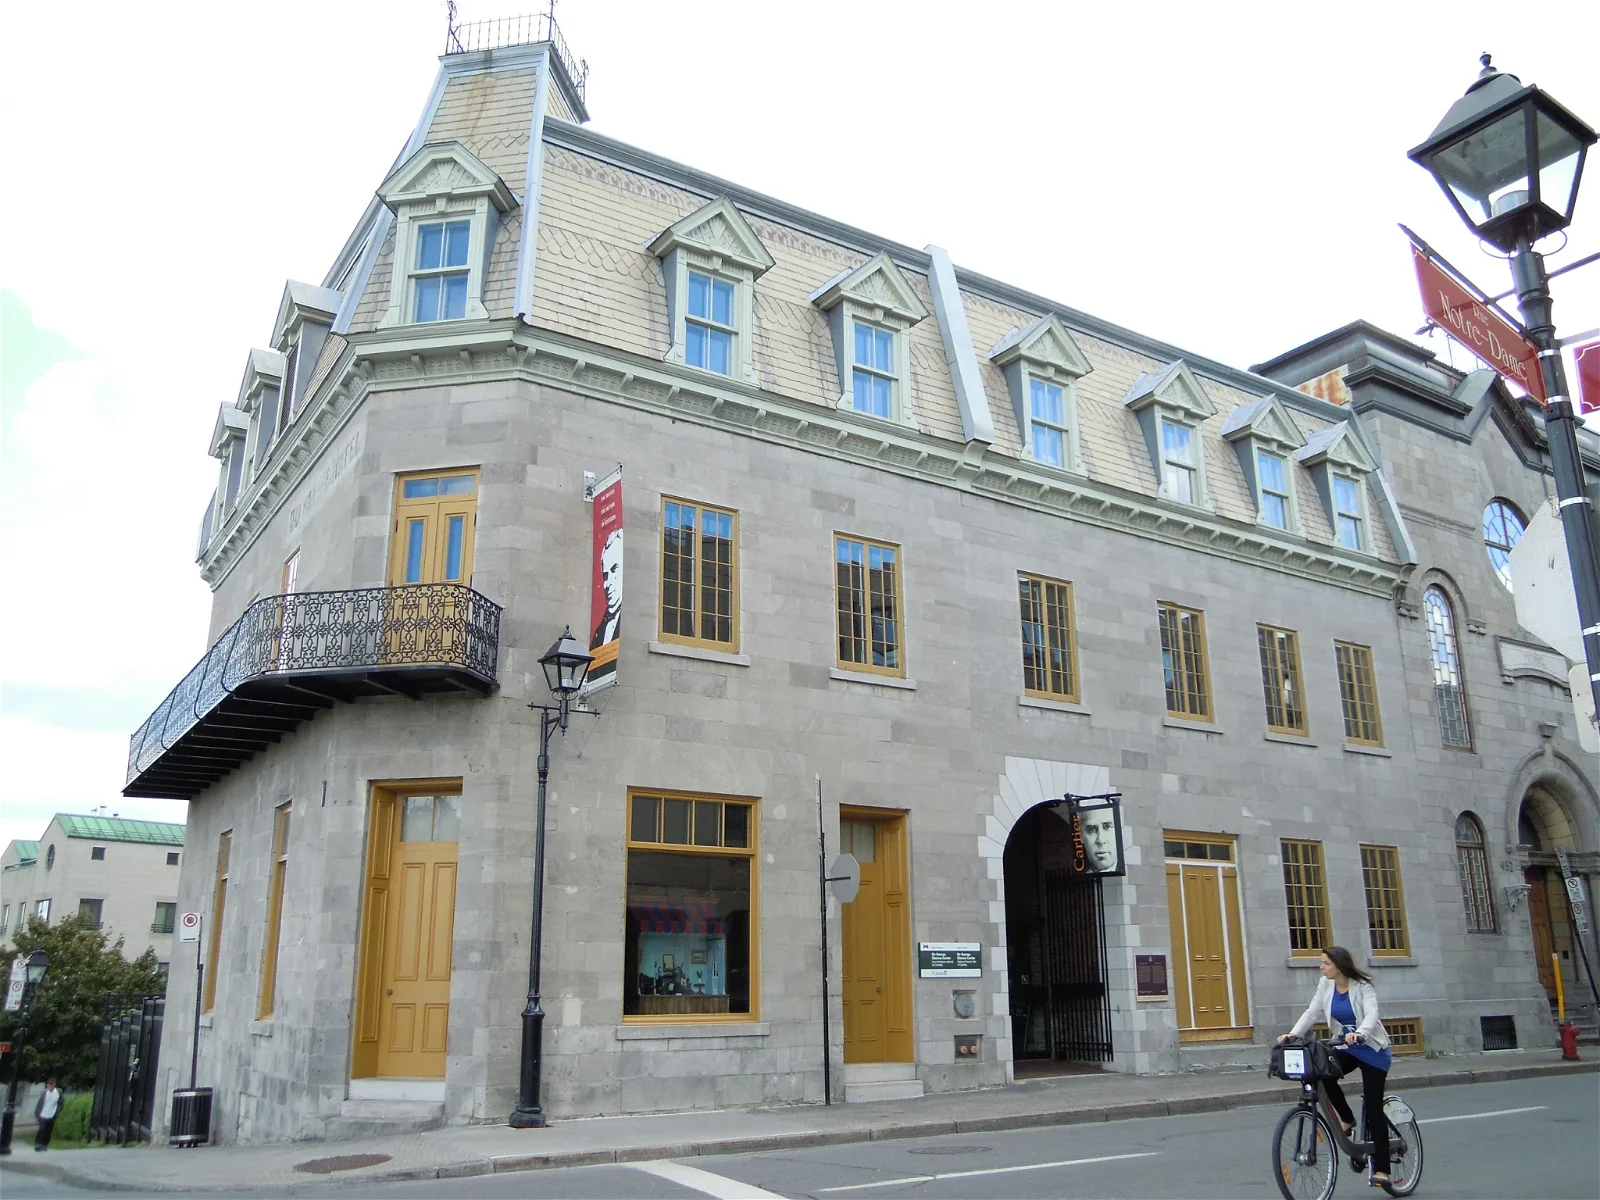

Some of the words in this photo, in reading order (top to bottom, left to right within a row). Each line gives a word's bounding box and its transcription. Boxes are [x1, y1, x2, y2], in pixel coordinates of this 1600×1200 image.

[1439, 290, 1527, 380] Notre-Dame
[1472, 302, 1489, 326] Rue
[1072, 815, 1085, 871] Cartier
